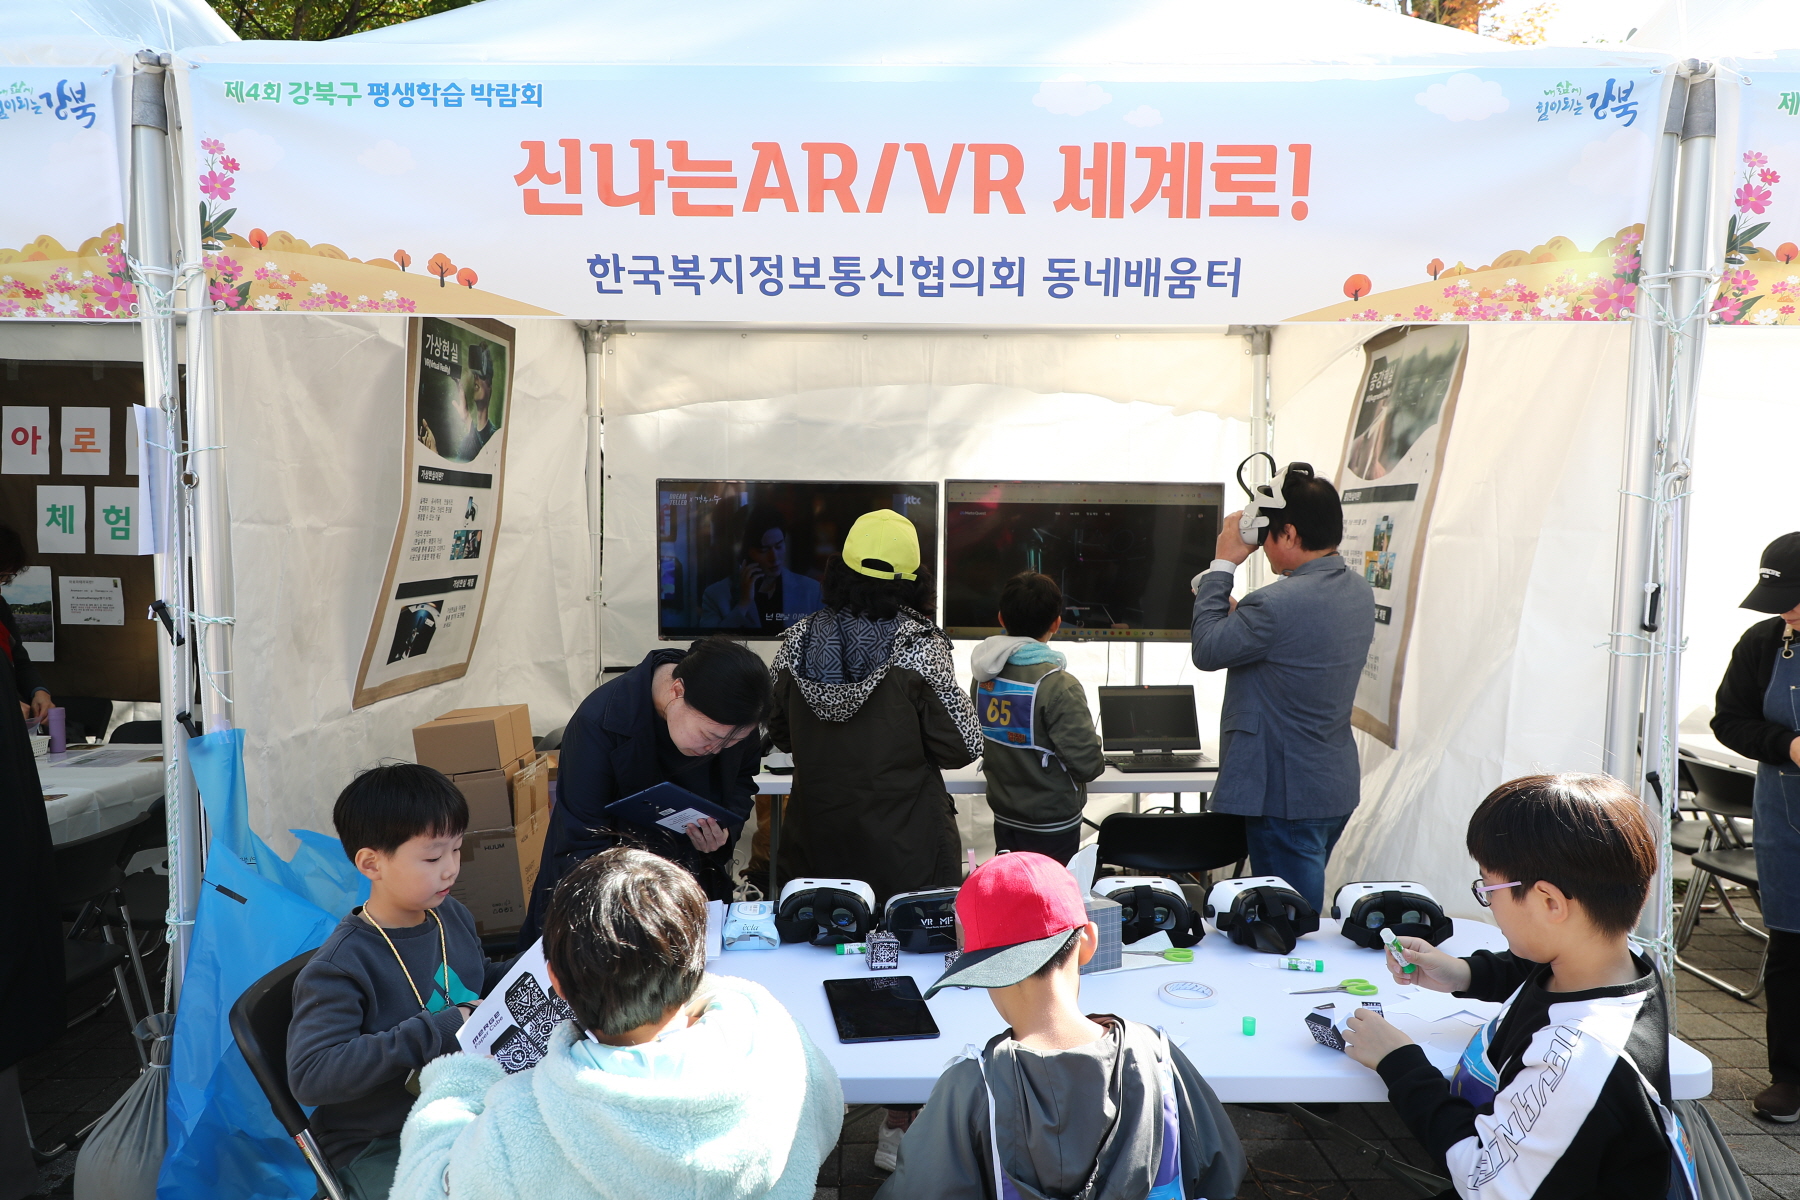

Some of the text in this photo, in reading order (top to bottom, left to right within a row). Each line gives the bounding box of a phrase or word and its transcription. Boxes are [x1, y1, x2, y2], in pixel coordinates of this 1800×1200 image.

[39, 79, 96, 129] 강북
[224, 80, 543, 108] 제4회 강북구 평생학습 박람회
[1586, 78, 1638, 127] 강북
[1777, 91, 1800, 116] 제
[513, 138, 1312, 222] 신나는AR/VR 세계로!
[586, 253, 1241, 299] 한국복지정보통신협의회 동네배움터
[986, 697, 1012, 726] 65
[920, 918, 933, 926] VR
